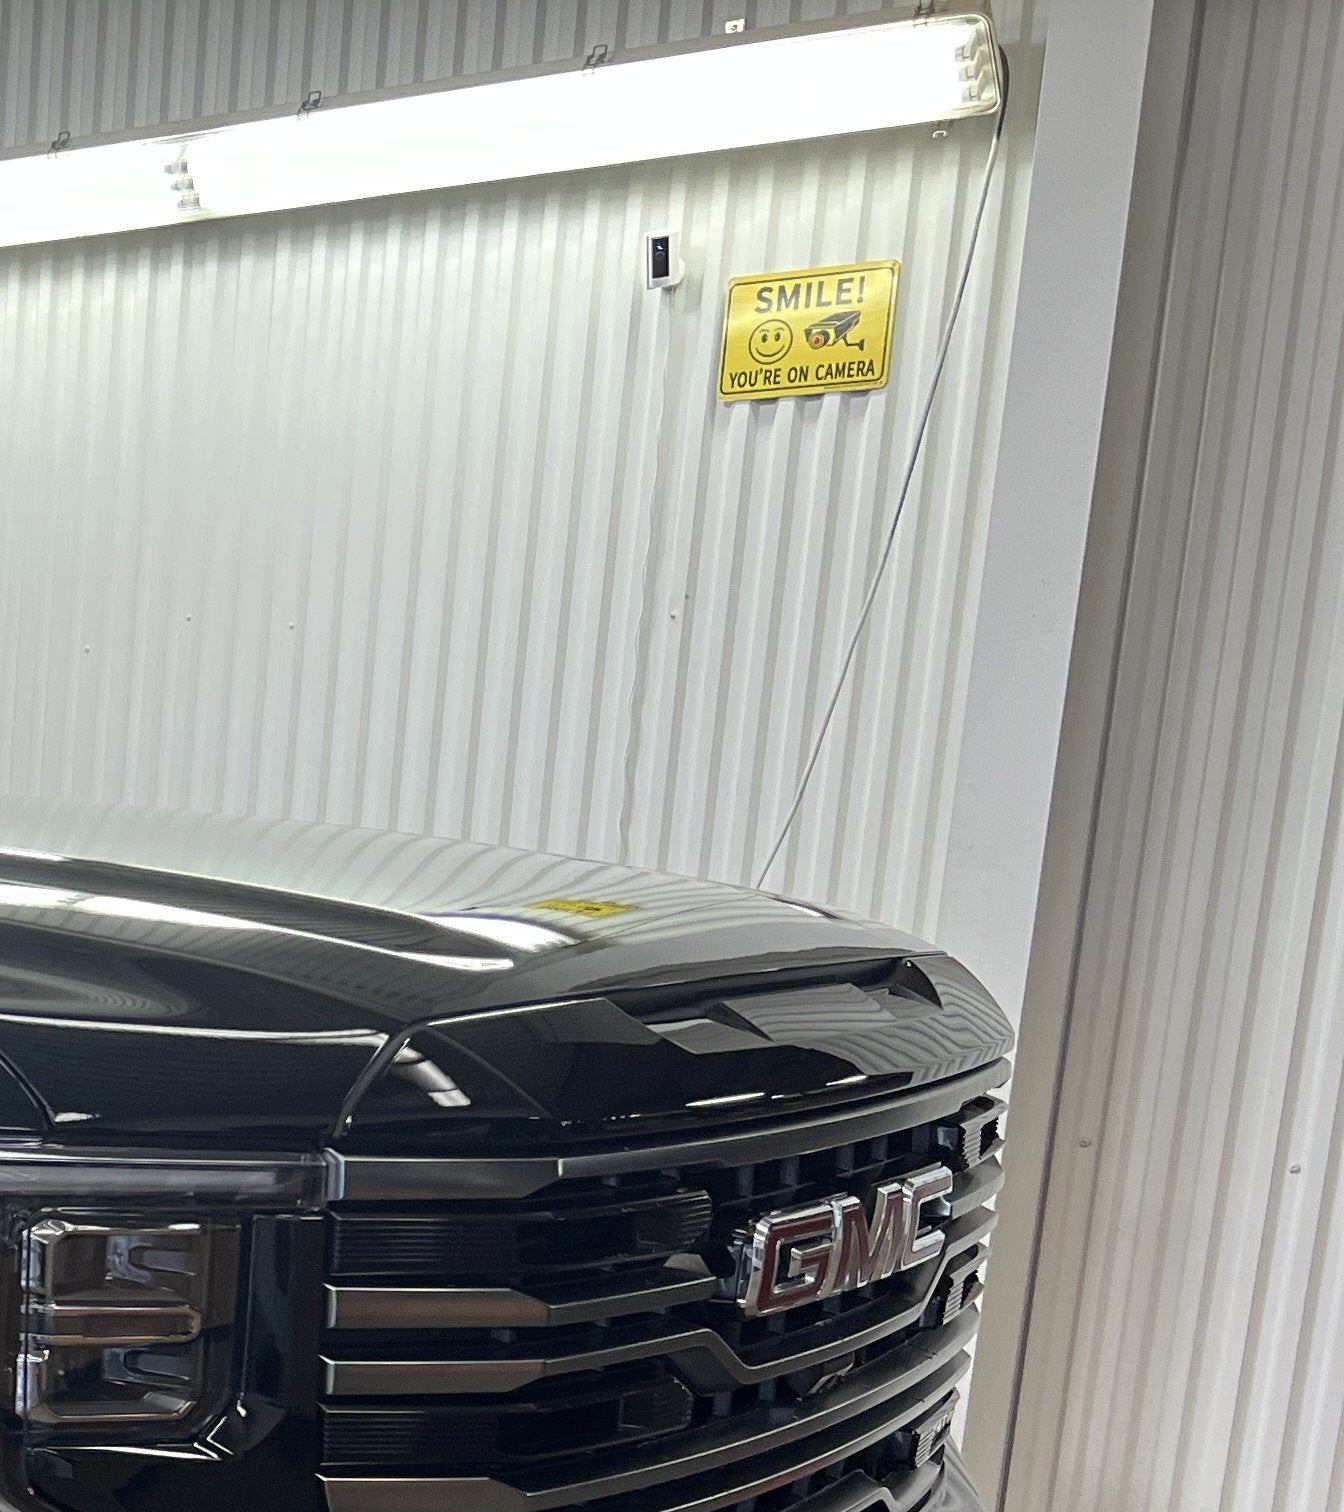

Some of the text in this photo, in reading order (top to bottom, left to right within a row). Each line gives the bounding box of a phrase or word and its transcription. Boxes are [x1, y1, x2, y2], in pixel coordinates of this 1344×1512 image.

[754, 276, 865, 314] SMILE!
[728, 358, 876, 389] YOU'RE ON CAMERA
[742, 1164, 953, 1318] GMC
